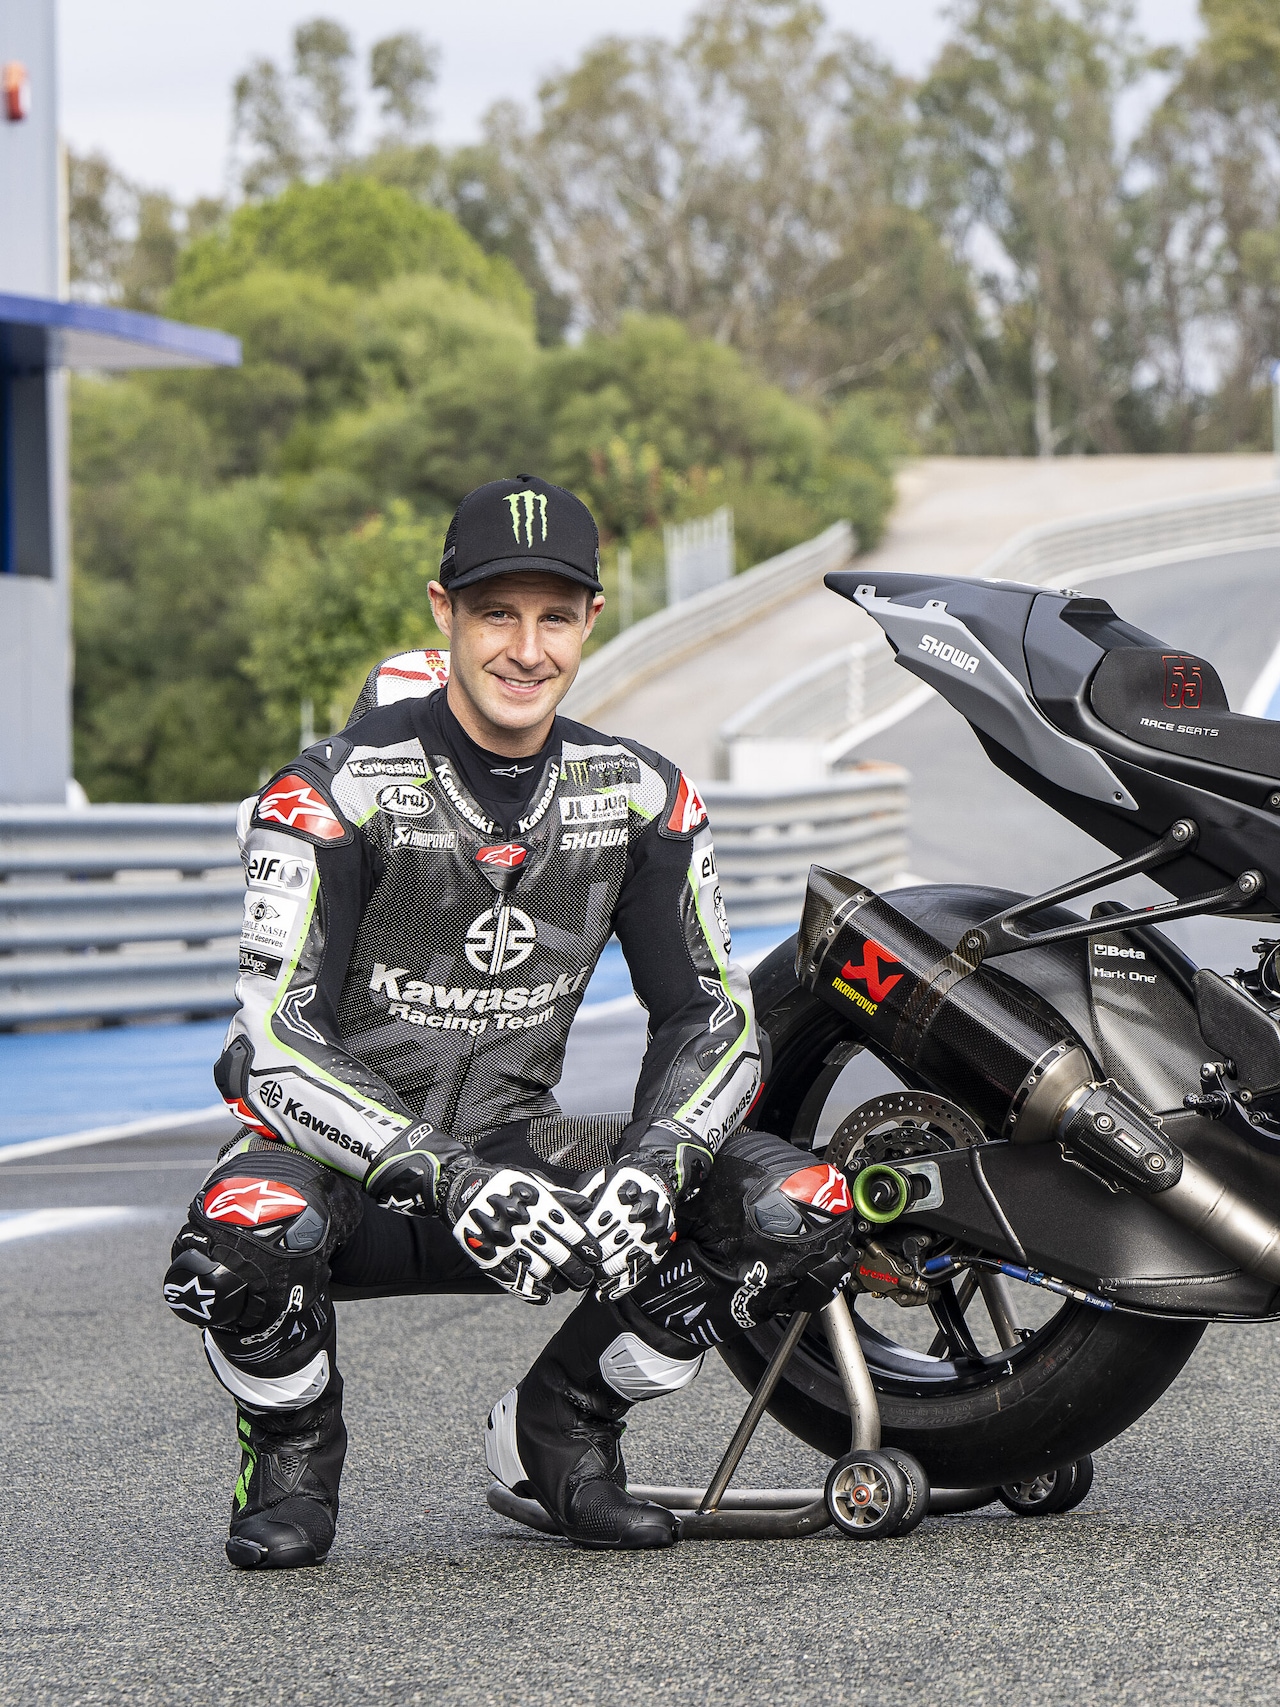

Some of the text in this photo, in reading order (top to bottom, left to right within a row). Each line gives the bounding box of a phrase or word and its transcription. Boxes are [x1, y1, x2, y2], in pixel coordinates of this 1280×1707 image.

[918, 634, 980, 674] SHOWA
[1140, 717, 1219, 737] RACE SEATS
[350, 760, 426, 776] Kawasaki
[381, 787, 426, 808] Arai
[435, 763, 495, 834] Kawasaki
[517, 762, 560, 834] Kawasaki
[560, 828, 628, 851] SHOWA
[247, 857, 280, 881] elf
[702, 851, 718, 878] el
[254, 933, 284, 948] deserves
[260, 923, 287, 938] NASH
[1107, 945, 1146, 960] Beta
[1093, 966, 1126, 979] Mark
[369, 963, 589, 1014] Kawasaki
[387, 1003, 554, 1036] Racing Team
[283, 1097, 379, 1163] Kawasak
[859, 1265, 899, 1285] brembo
